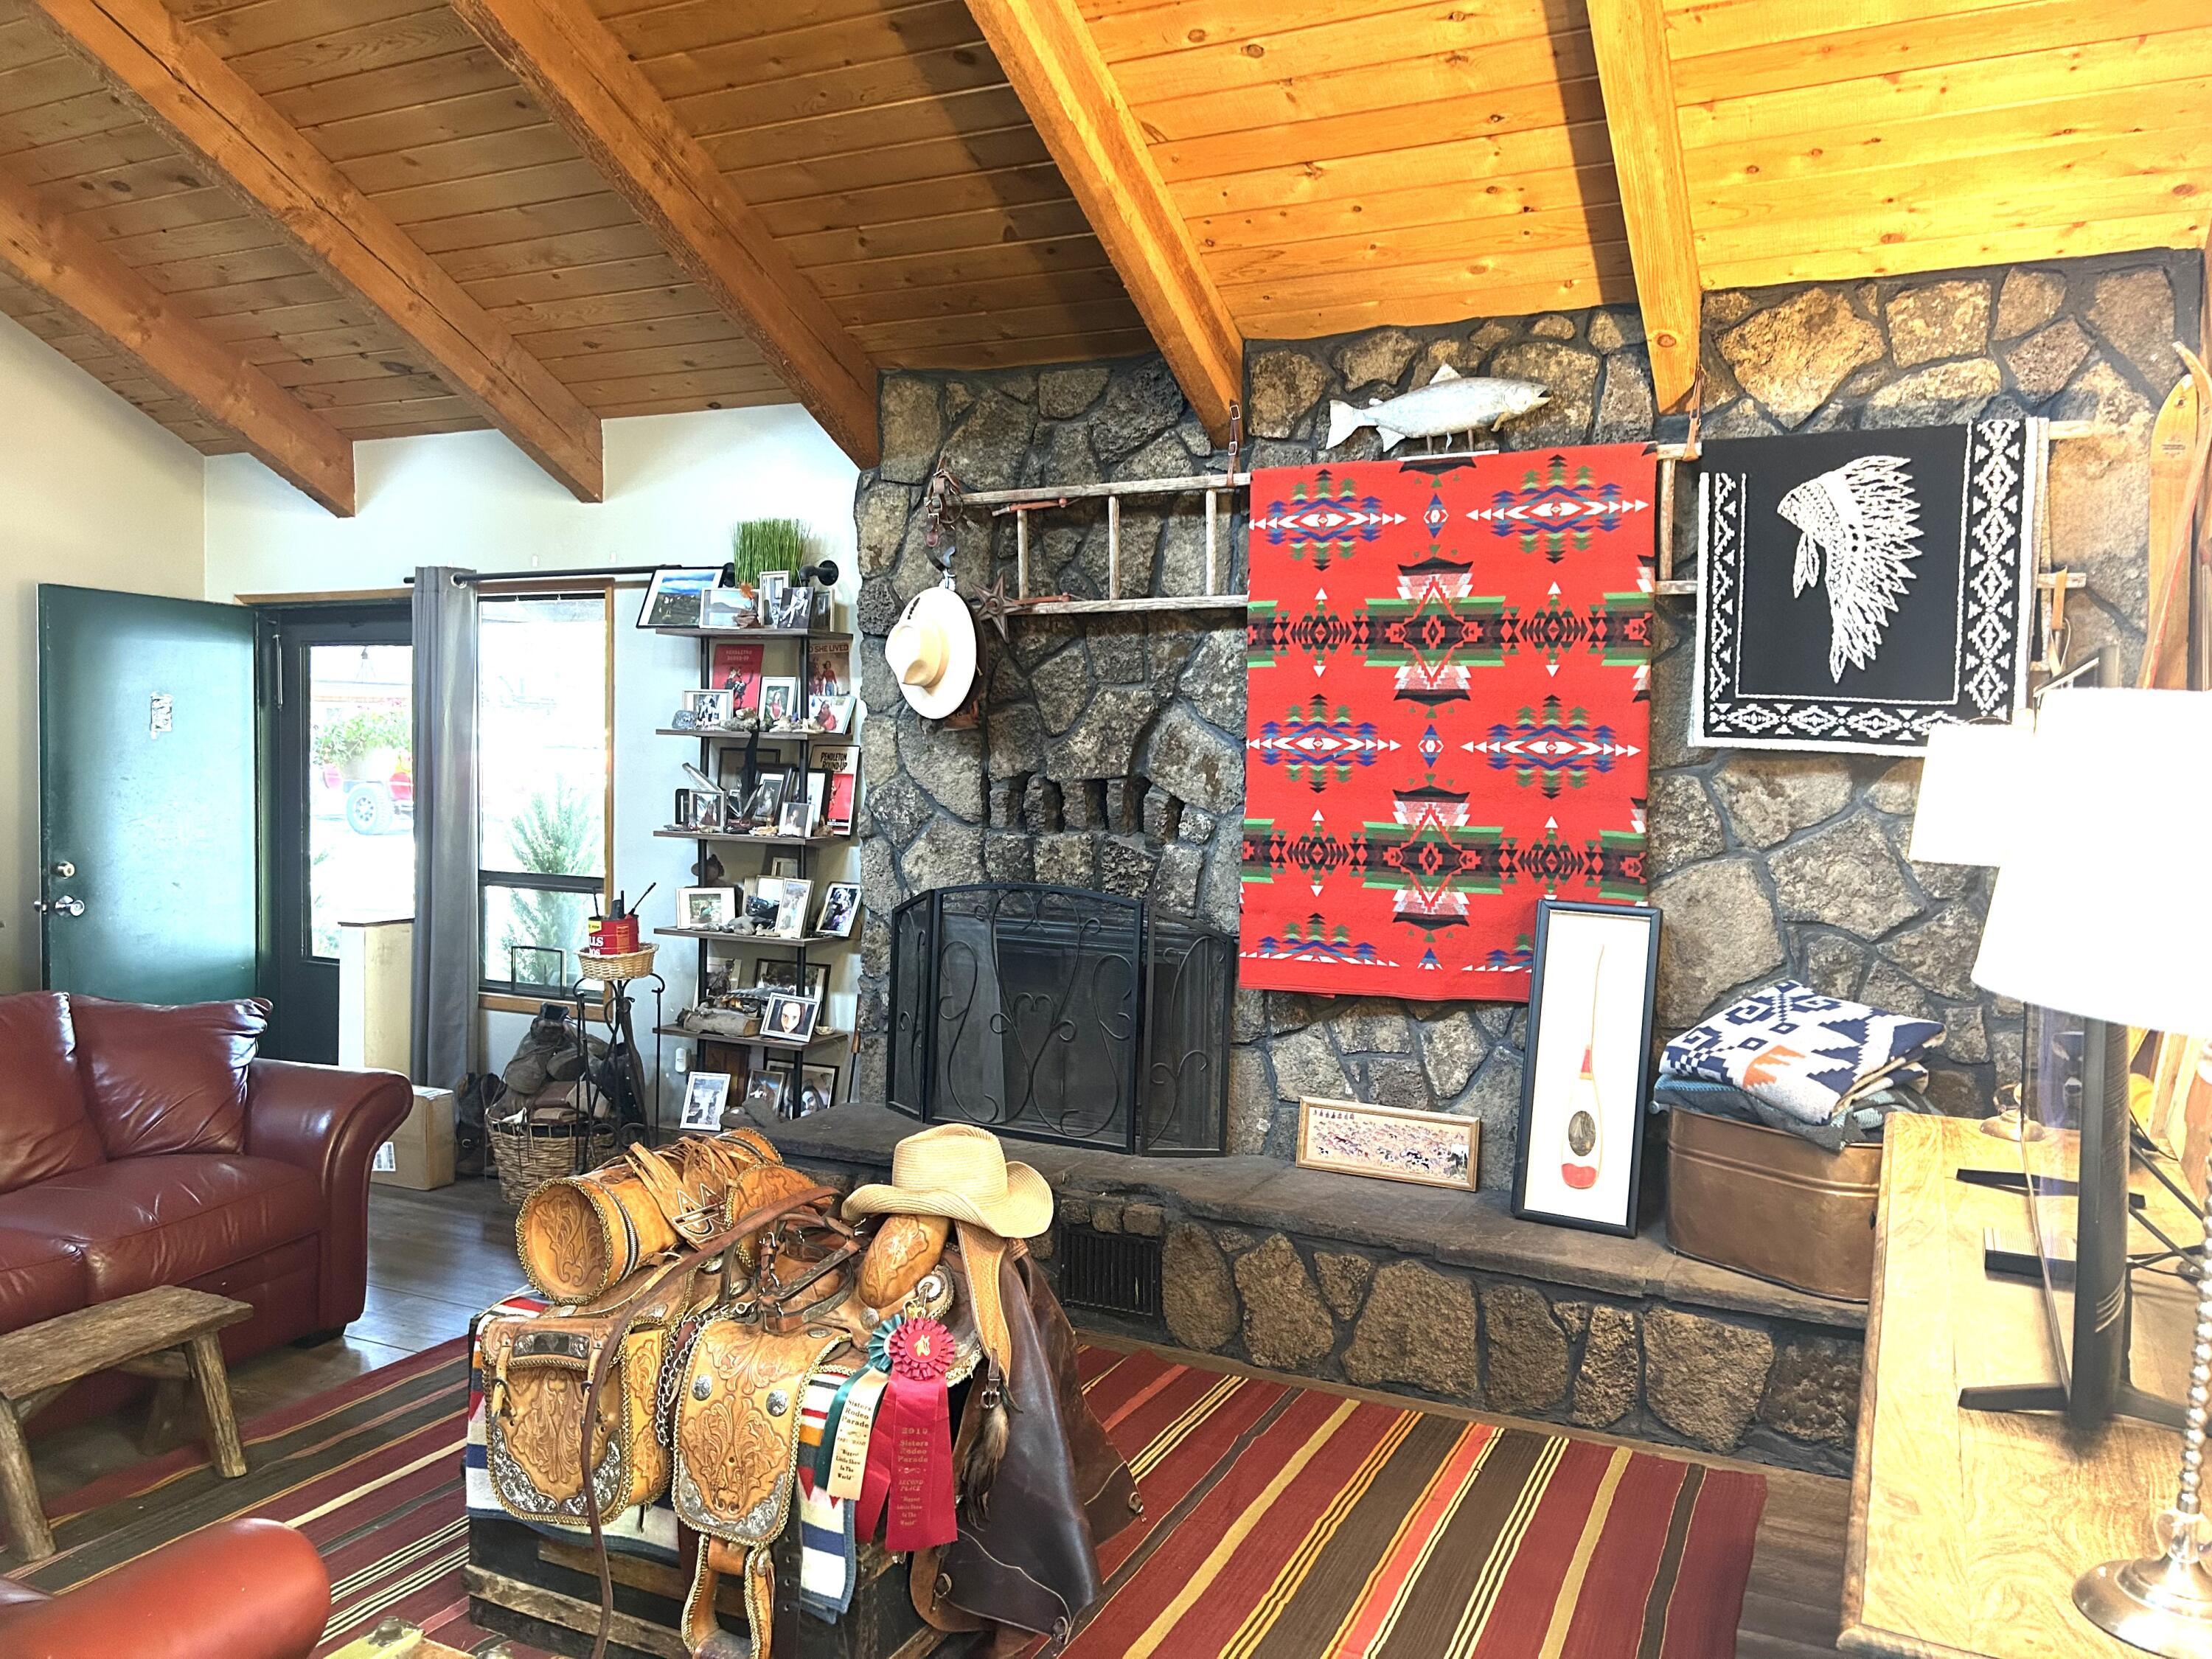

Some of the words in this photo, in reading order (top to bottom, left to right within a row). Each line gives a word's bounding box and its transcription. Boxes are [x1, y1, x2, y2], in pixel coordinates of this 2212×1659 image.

[815, 644, 828, 653] SHE
[829, 643, 849, 652] LIVED
[821, 752, 847, 762] PENDLETON
[822, 760, 847, 771] ROUND-UP
[848, 1399, 872, 1411] Sisters
[845, 1408, 869, 1420] Rodeo
[841, 1416, 869, 1429] Parade
[900, 1439, 929, 1447] Sisters
[835, 1455, 848, 1464] Little
[897, 1455, 928, 1463] Parade
